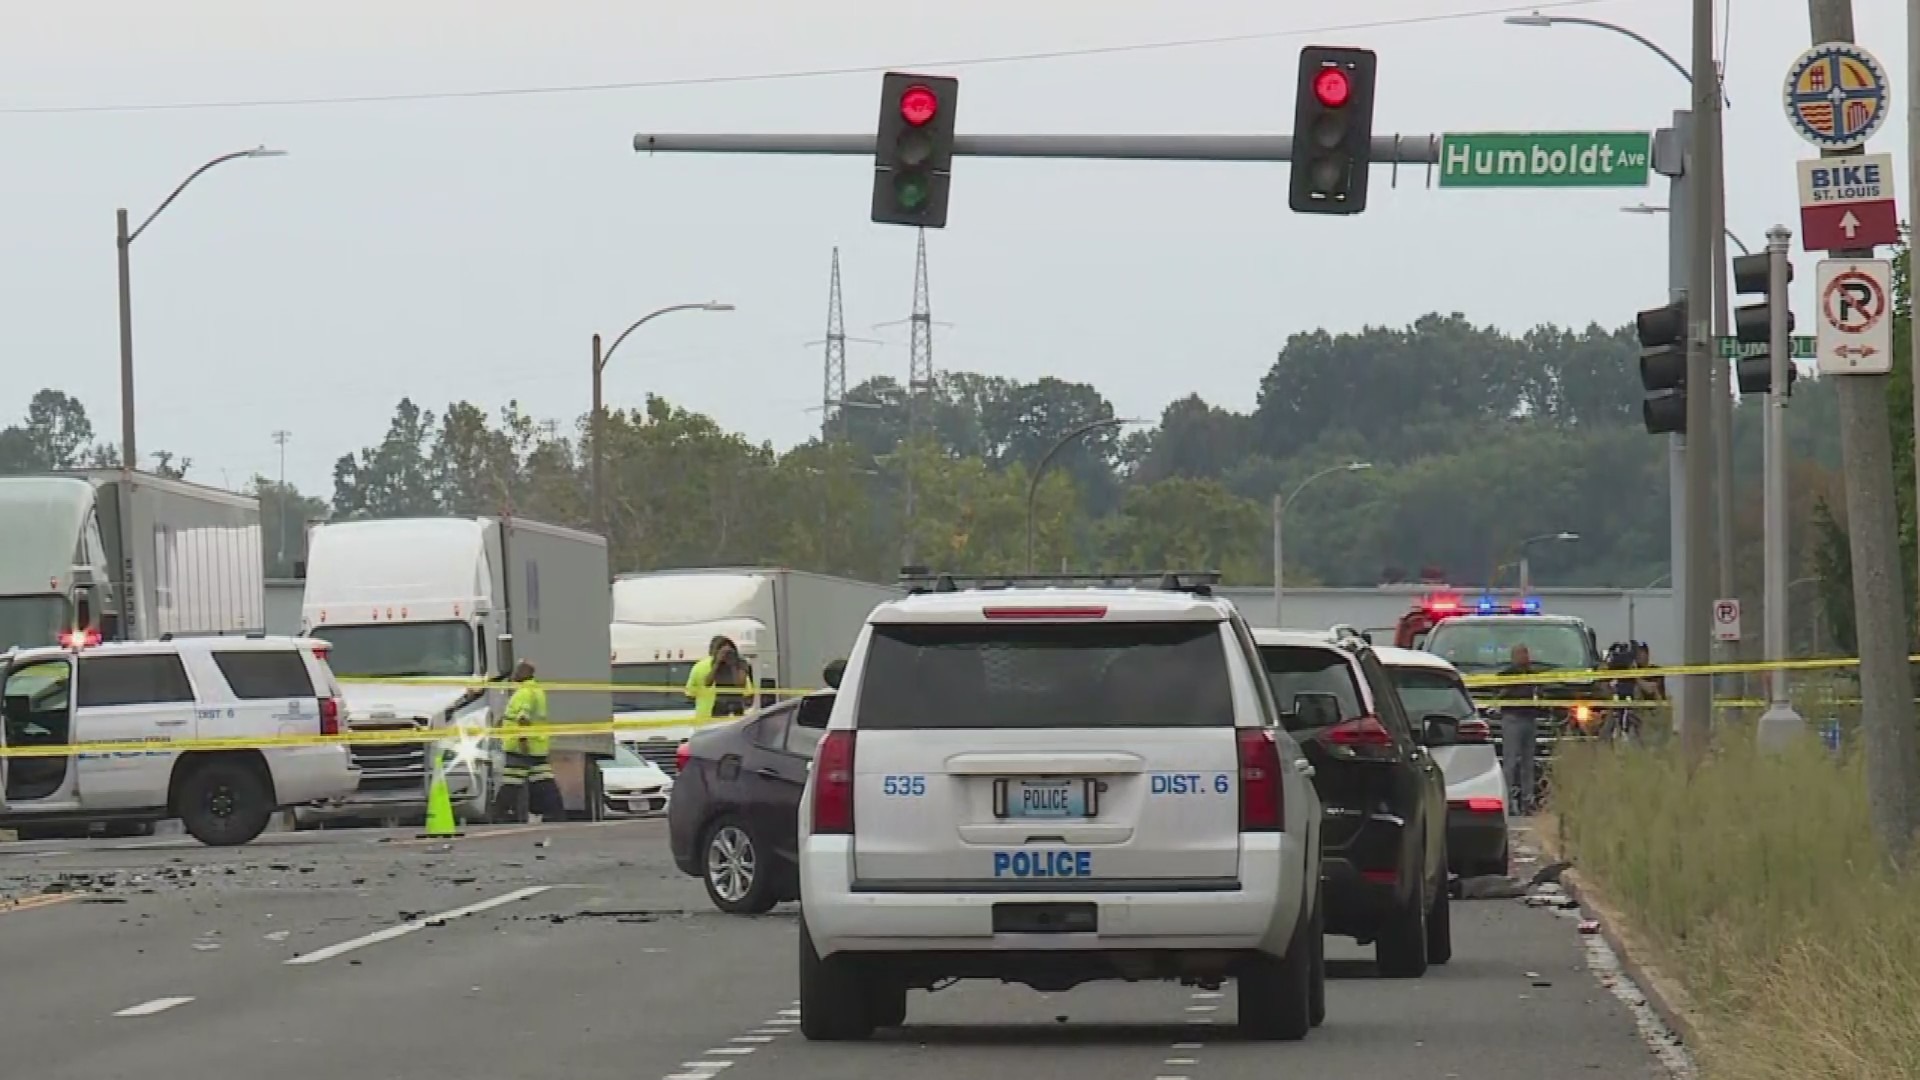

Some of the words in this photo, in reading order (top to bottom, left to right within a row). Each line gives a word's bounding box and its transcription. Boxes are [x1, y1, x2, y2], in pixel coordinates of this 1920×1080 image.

[1446, 143, 1614, 175] Humboldt
[1616, 149, 1646, 167] Ave
[1811, 163, 1881, 188] BIKE
[1813, 189, 1834, 201] ST.
[1838, 186, 1880, 199] LOUIS
[883, 775, 926, 796] 535
[1150, 774, 1206, 795] DIST.
[1214, 774, 1230, 793] 6
[1023, 789, 1069, 810] POLICE
[993, 851, 1092, 878] POLICE
